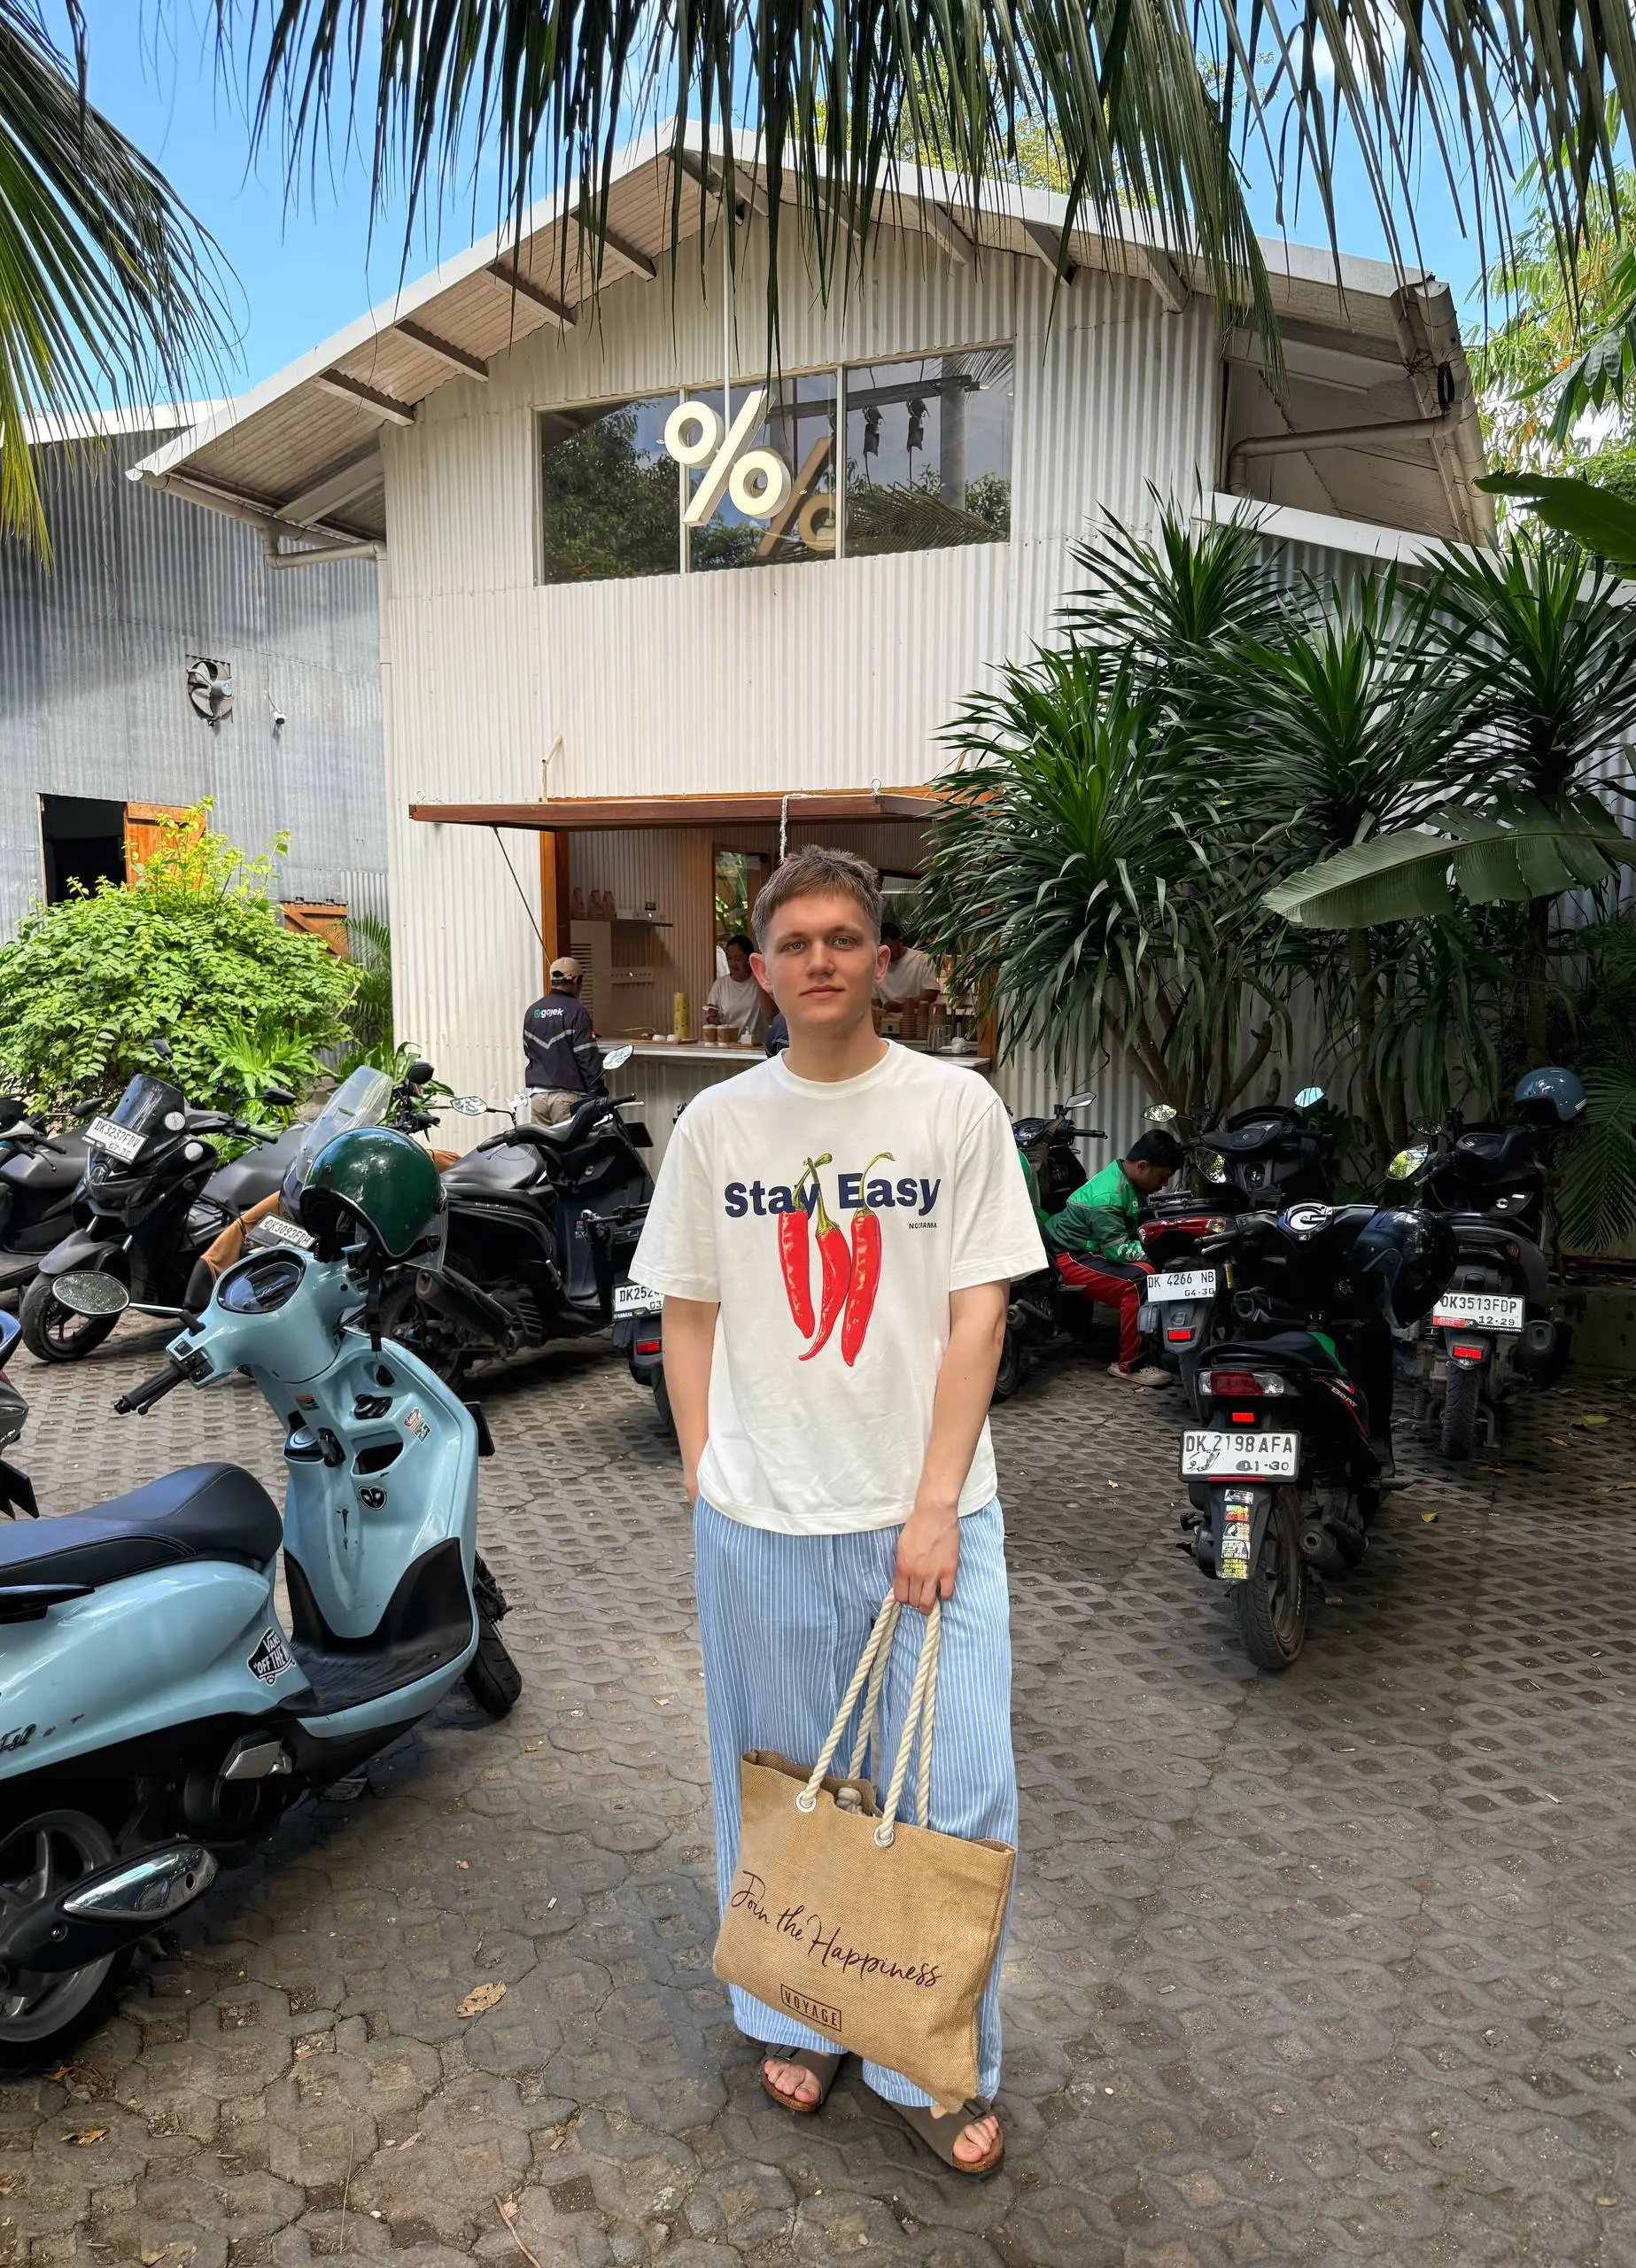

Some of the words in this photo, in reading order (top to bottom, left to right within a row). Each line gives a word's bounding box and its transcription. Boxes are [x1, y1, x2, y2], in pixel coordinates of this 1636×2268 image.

[540, 1007, 564, 1018] gojek
[725, 1180, 821, 1219] Stay
[837, 1173, 942, 1216] Easy
[1148, 1276, 1161, 1288] DK
[1167, 1273, 1192, 1286] 4266
[1201, 1271, 1214, 1284] NB
[619, 1286, 660, 1302] DK252
[731, 1870, 771, 1924] Join
[776, 1905, 804, 1941] the
[807, 1914, 943, 1988] Happiness
[784, 1991, 838, 2027] VOYAGE
